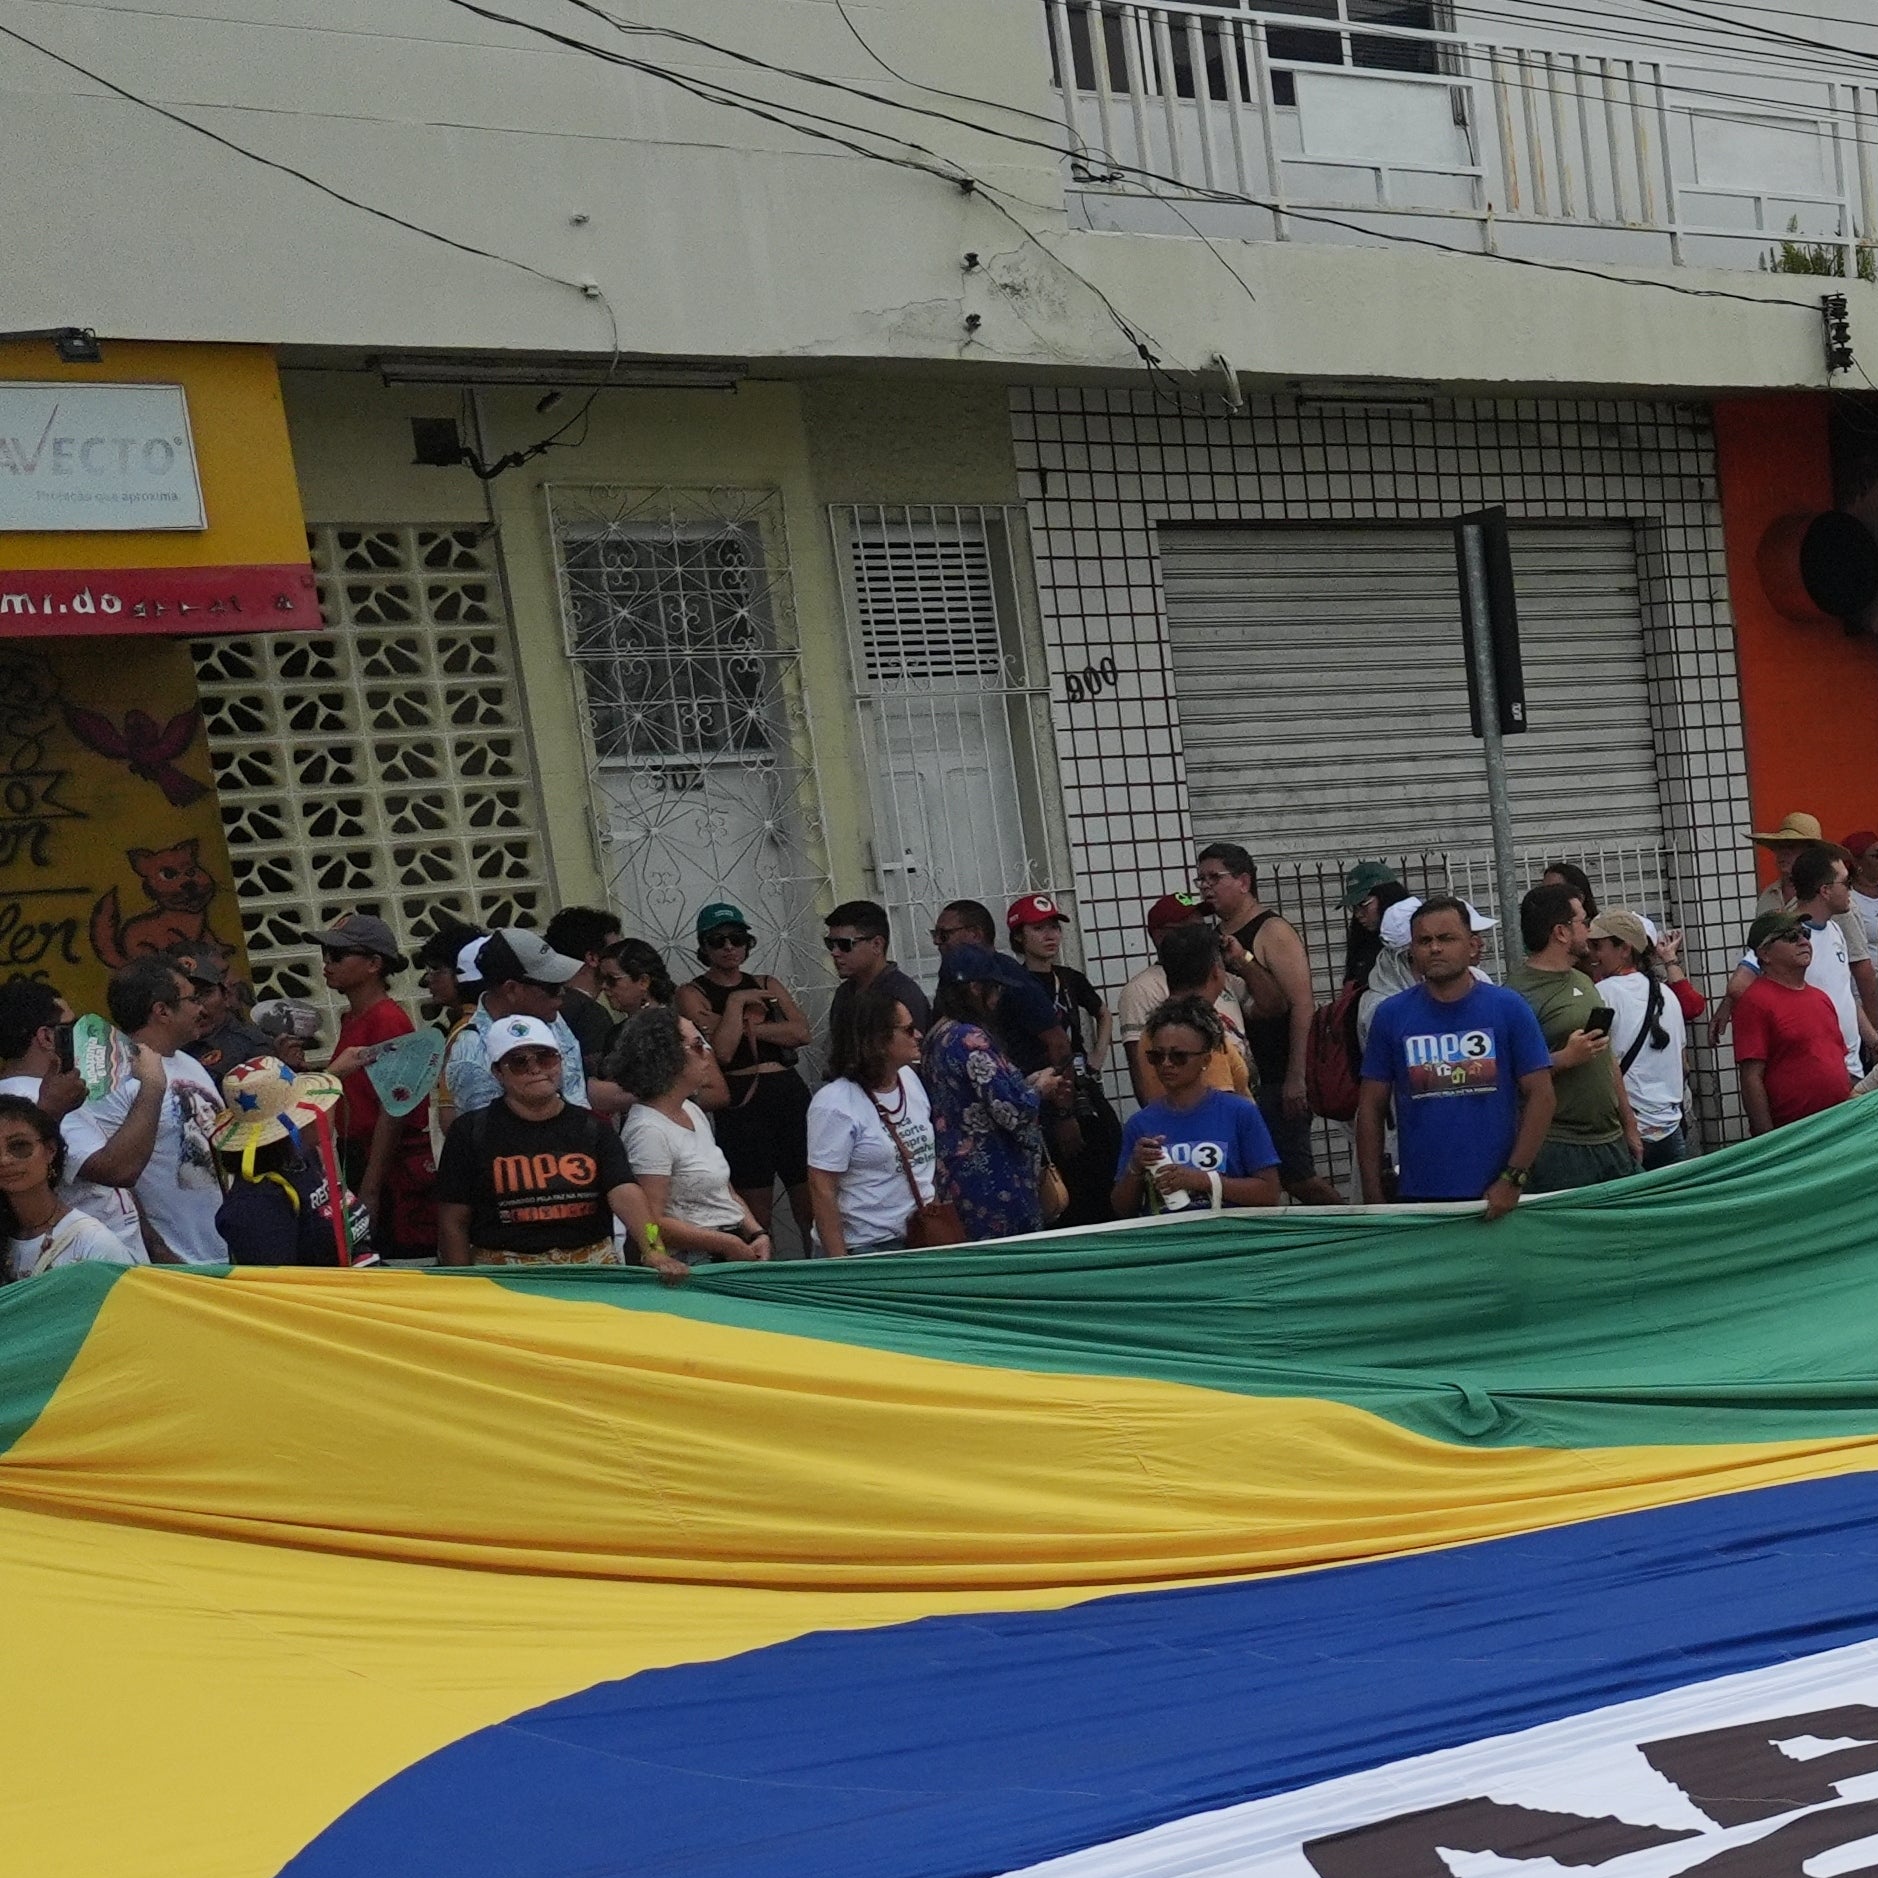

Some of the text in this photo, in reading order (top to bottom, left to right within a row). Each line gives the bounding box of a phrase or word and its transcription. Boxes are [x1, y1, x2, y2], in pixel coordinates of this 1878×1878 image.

[121, 490, 178, 503] aproxima
[1406, 1030, 1492, 1067] MP3
[493, 1152, 597, 1194] MP3
